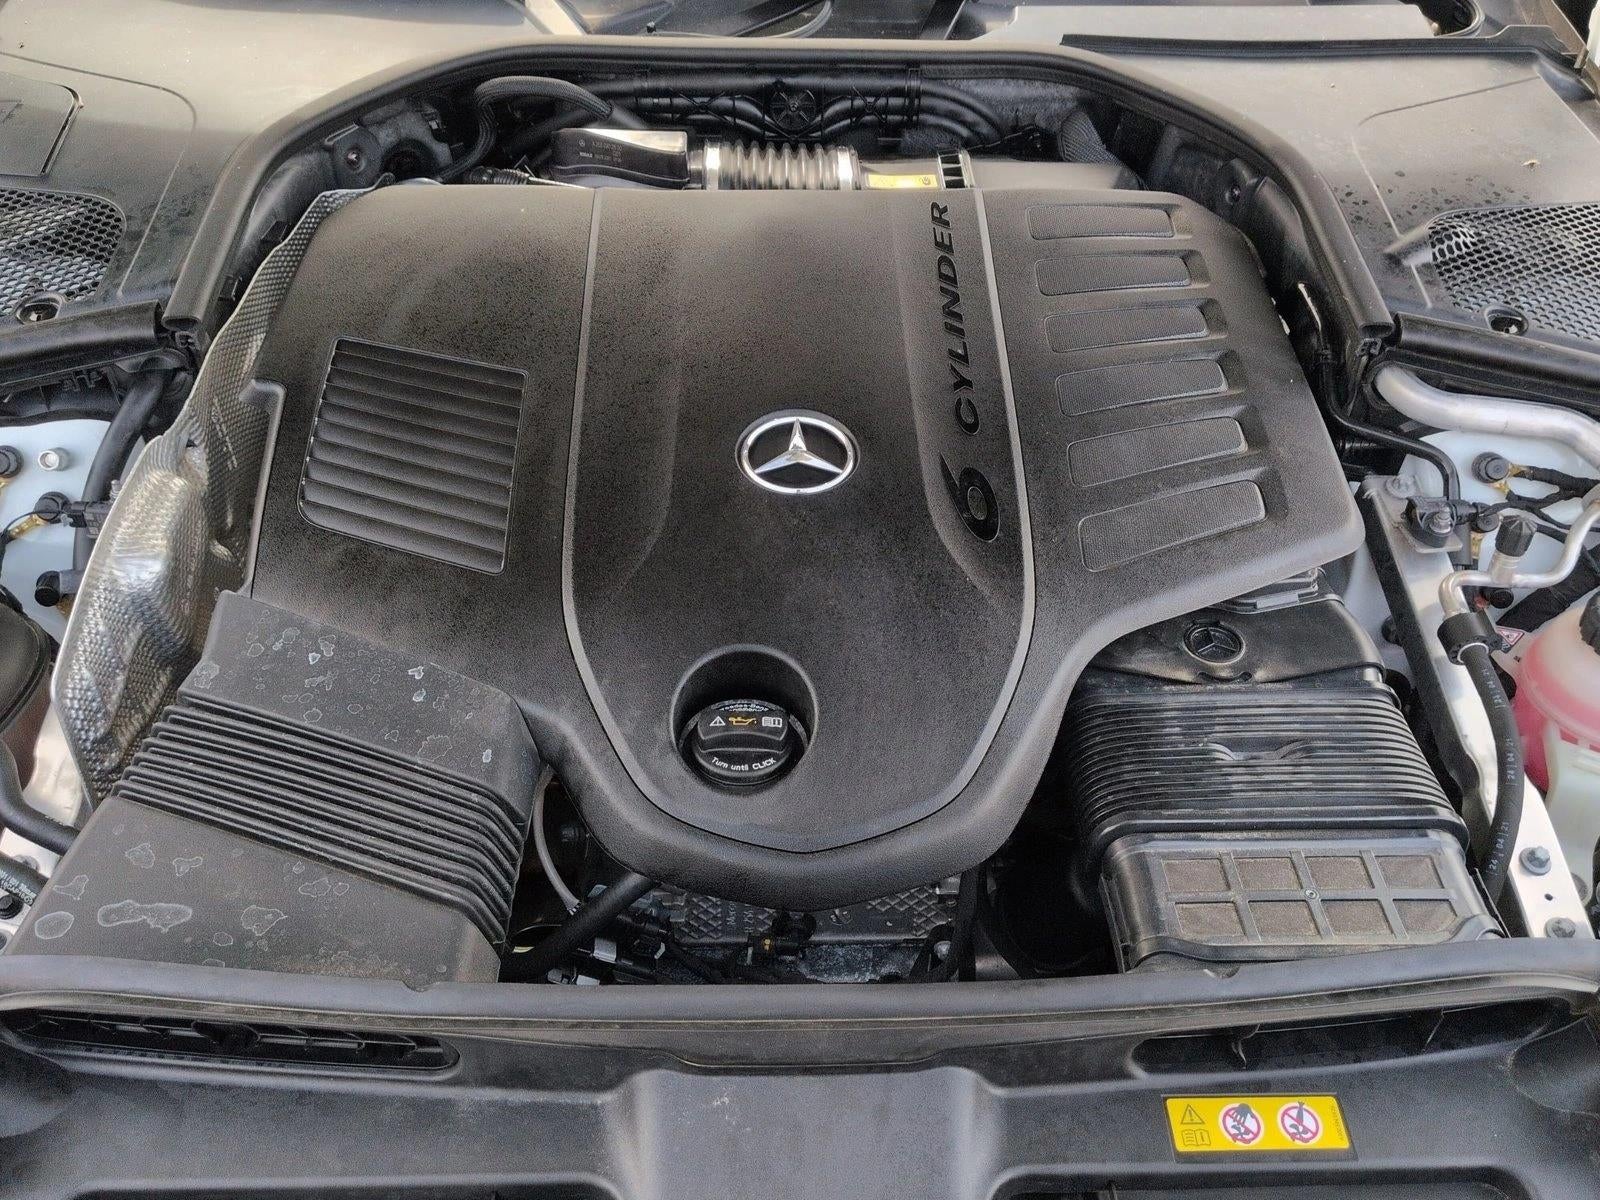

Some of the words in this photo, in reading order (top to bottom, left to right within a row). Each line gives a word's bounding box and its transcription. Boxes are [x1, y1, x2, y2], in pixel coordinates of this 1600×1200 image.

[931, 201, 981, 436] CYLINDER
[939, 453, 1000, 544] 6
[712, 757, 728, 768] Turn
[752, 757, 776, 770] CLICK
